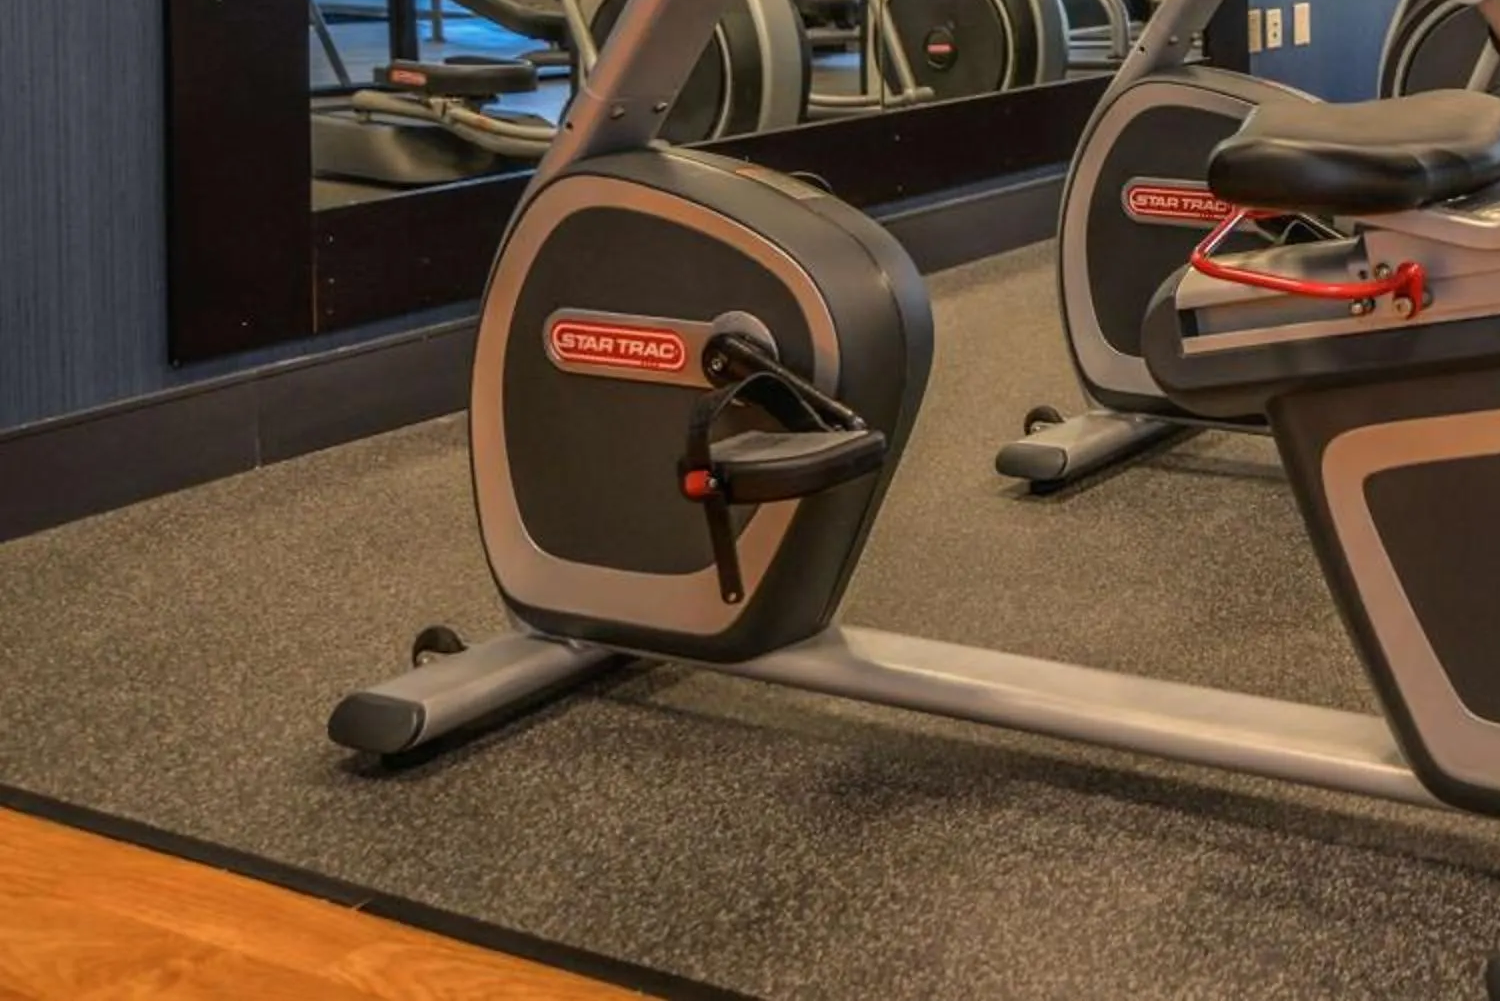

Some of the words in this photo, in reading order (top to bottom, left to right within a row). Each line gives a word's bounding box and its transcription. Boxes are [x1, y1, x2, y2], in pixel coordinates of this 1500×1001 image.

[1134, 194, 1180, 209] STAR
[1182, 198, 1227, 212] TRAC
[559, 332, 614, 353] STAR
[616, 339, 676, 359] TRAC
